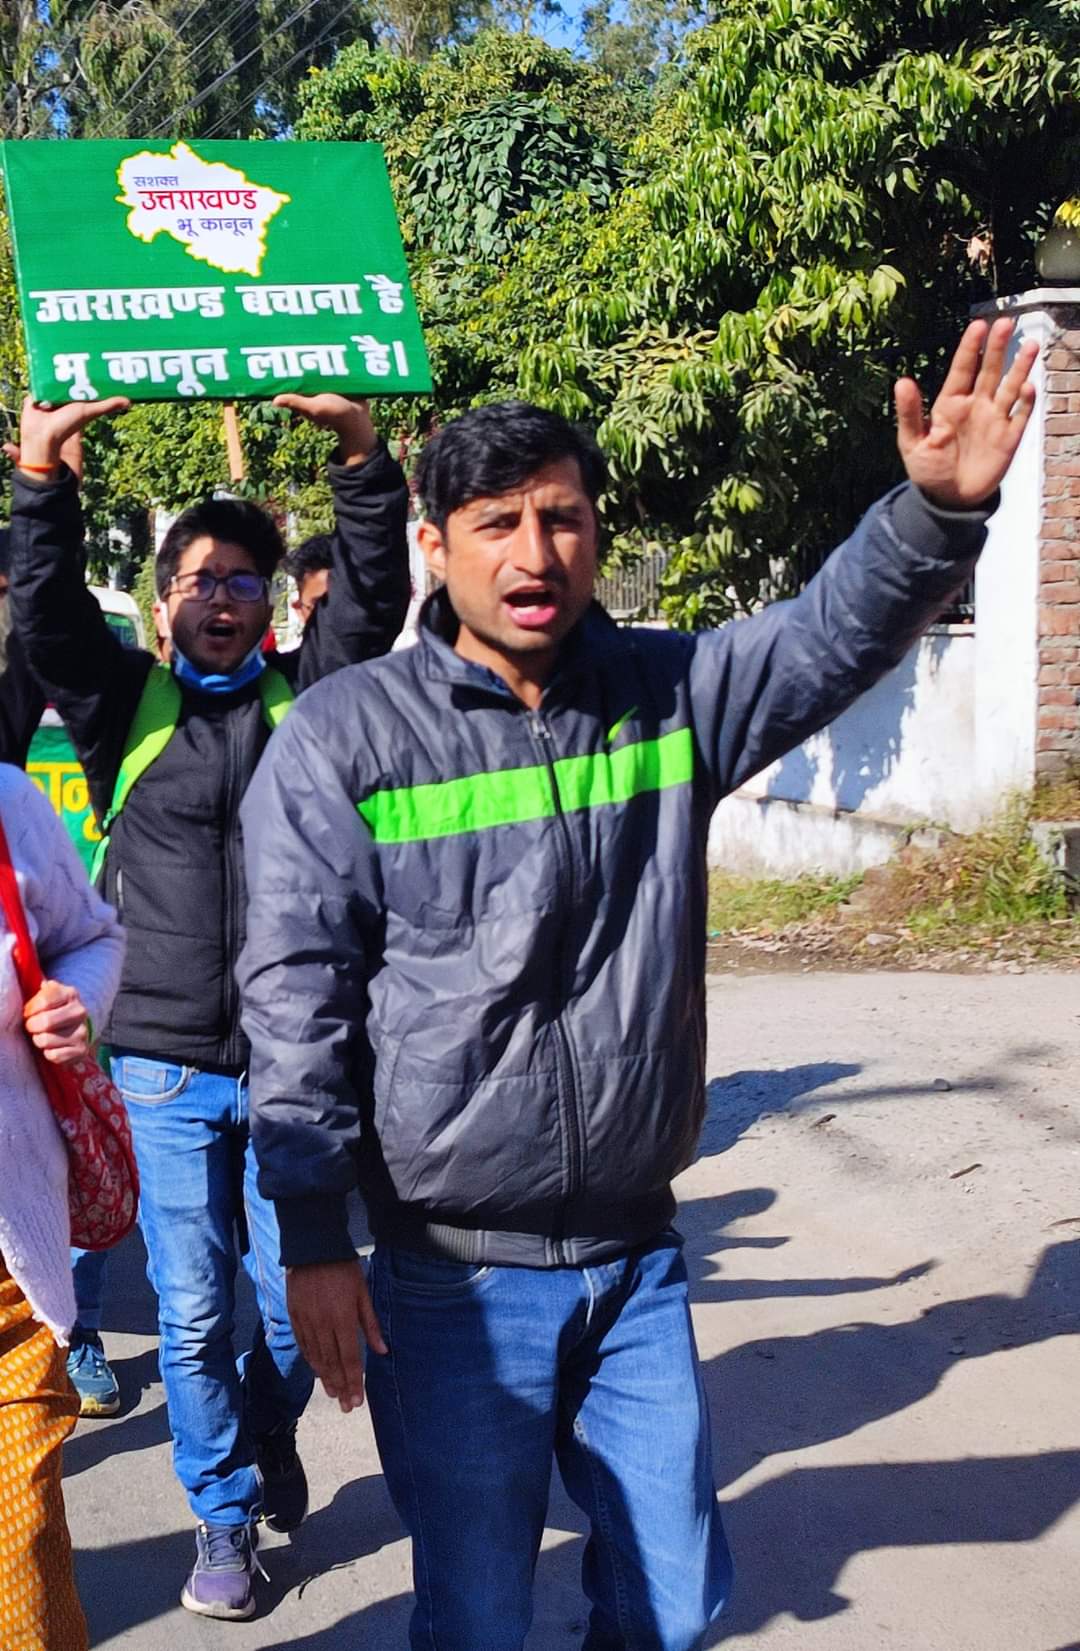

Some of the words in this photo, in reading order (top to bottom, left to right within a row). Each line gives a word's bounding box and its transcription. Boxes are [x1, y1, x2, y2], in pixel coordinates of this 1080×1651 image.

[133, 175, 180, 187] सशक्त
[138, 189, 259, 210] उत्तराखण्ड
[177, 217, 199, 236] भू
[199, 217, 254, 236] कानून
[28, 286, 226, 323] उत्तराखण्ड
[234, 283, 363, 316] बचाना
[363, 274, 405, 314] है
[52, 352, 99, 400] भू
[101, 347, 230, 397] कानून
[239, 344, 350, 379] लाना
